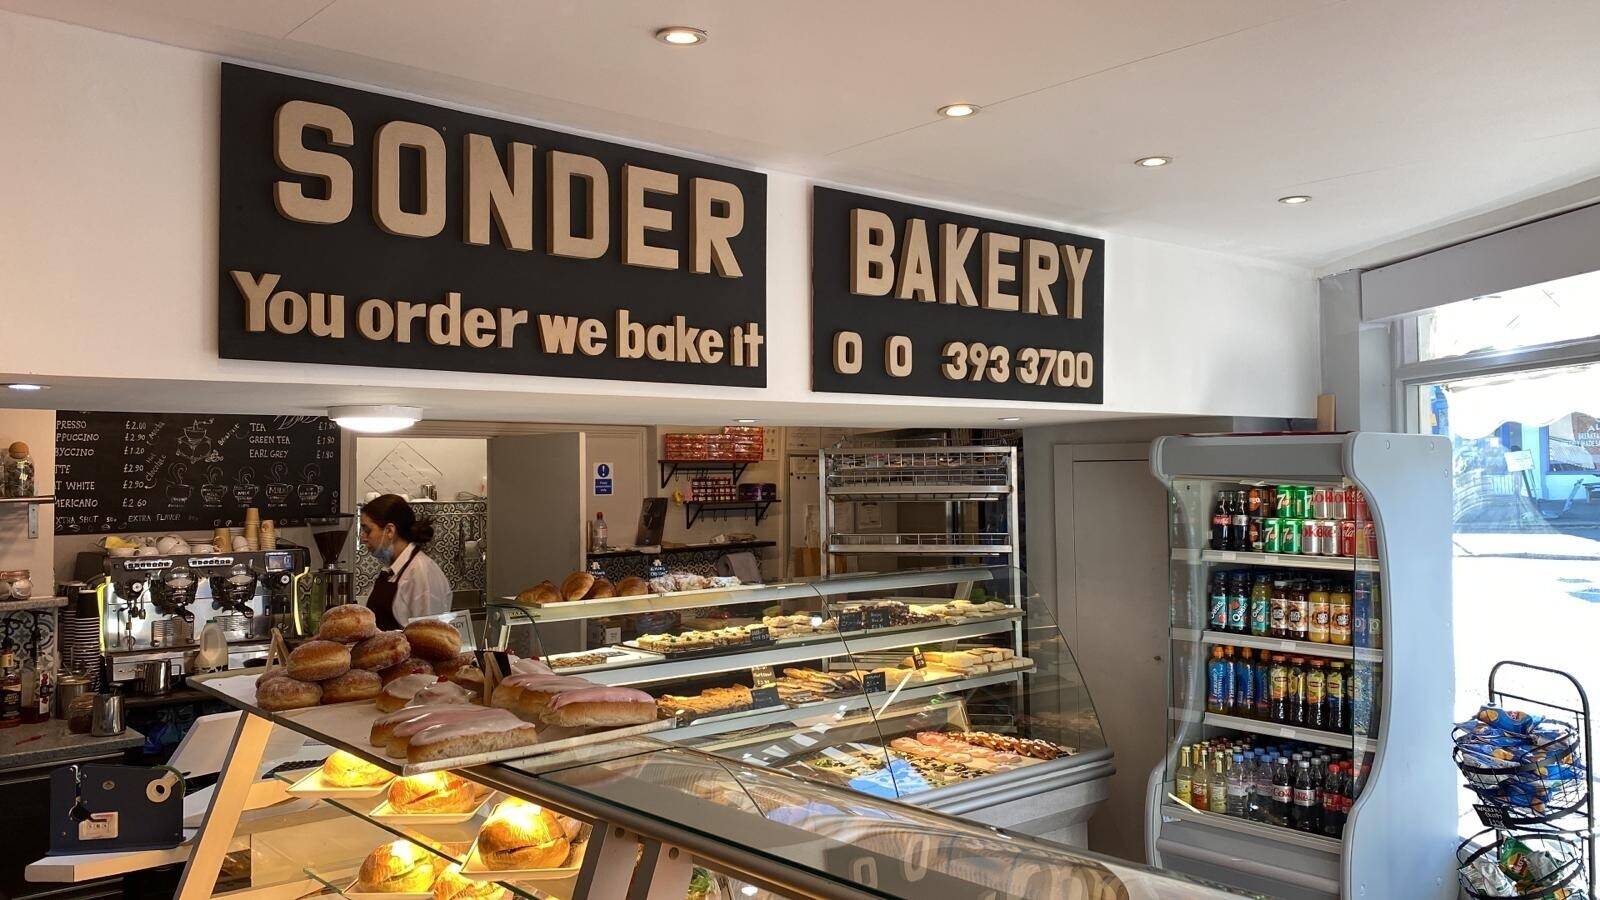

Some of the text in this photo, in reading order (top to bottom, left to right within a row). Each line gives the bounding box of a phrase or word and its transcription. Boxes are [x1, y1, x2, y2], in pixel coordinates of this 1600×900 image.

[273, 99, 744, 279] SONDER
[850, 208, 1093, 319] BAKERY
[228, 270, 763, 367] You order we bake it
[942, 341, 1010, 383] 393
[1016, 347, 1093, 389] 3700
[56, 420, 147, 430] PRESSO £2.00
[249, 422, 266, 432] TEA
[248, 435, 275, 444] GREEN
[276, 435, 291, 445] TEA
[249, 449, 268, 458] EARL
[269, 449, 289, 459] GREY
[66, 481, 96, 490] WHITE
[79, 515, 100, 523] SHOT
[128, 514, 152, 523] EXTRA
